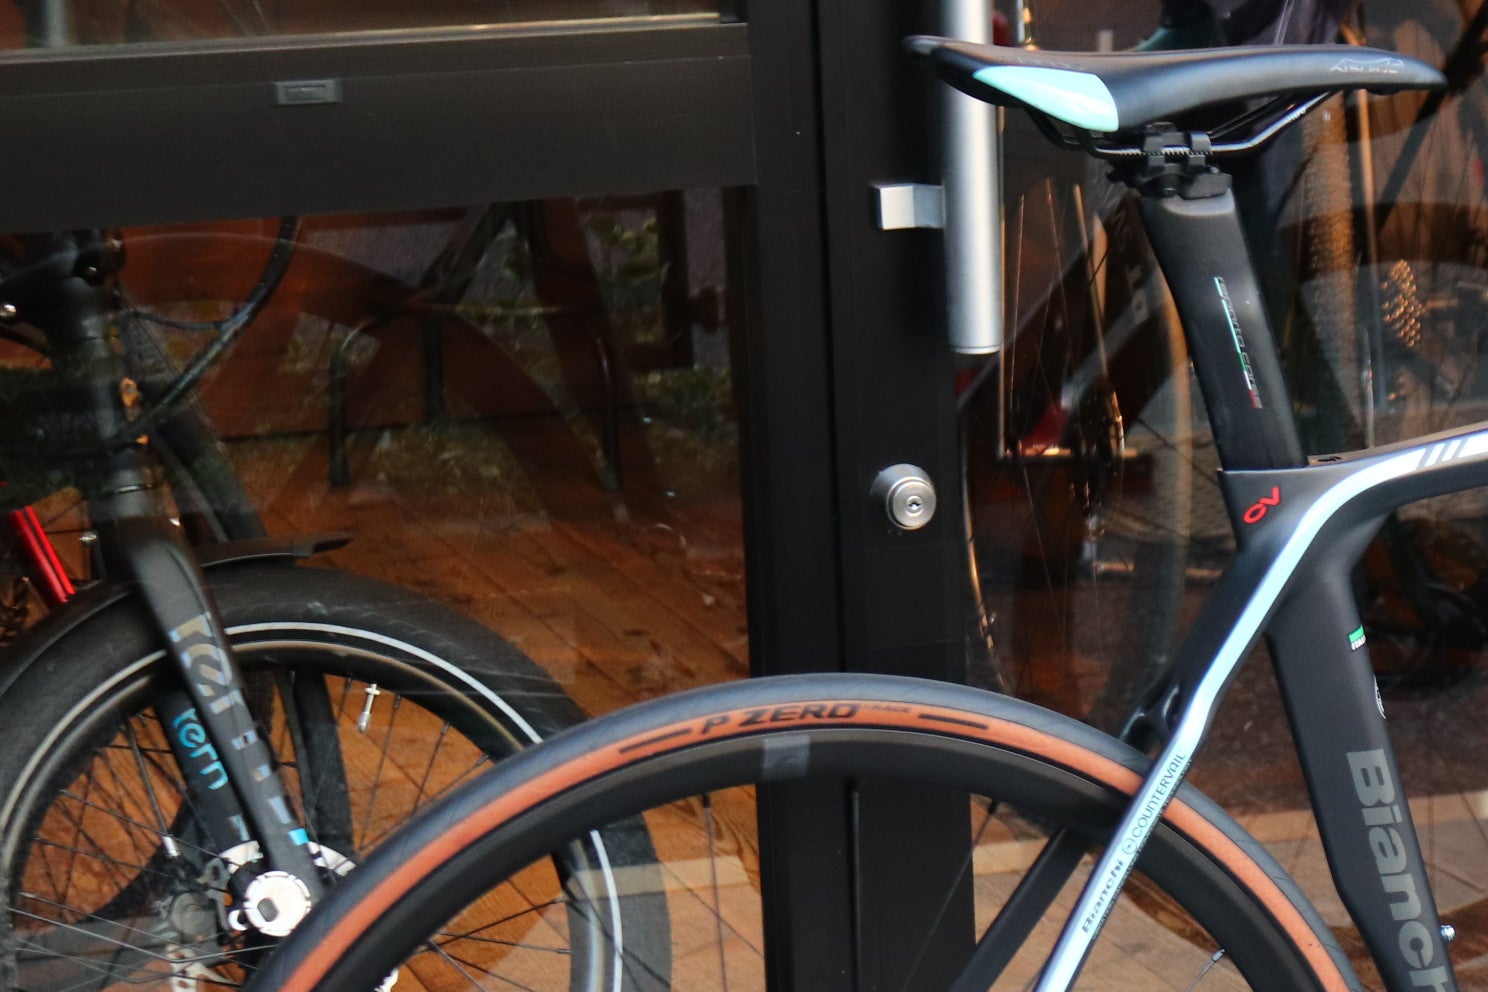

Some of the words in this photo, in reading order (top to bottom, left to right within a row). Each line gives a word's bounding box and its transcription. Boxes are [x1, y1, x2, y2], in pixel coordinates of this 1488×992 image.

[701, 713, 730, 735] P
[738, 702, 861, 728] ZERO
[1081, 858, 1125, 935] Bianchi
[1131, 752, 1187, 839] COUNTERVAIL
